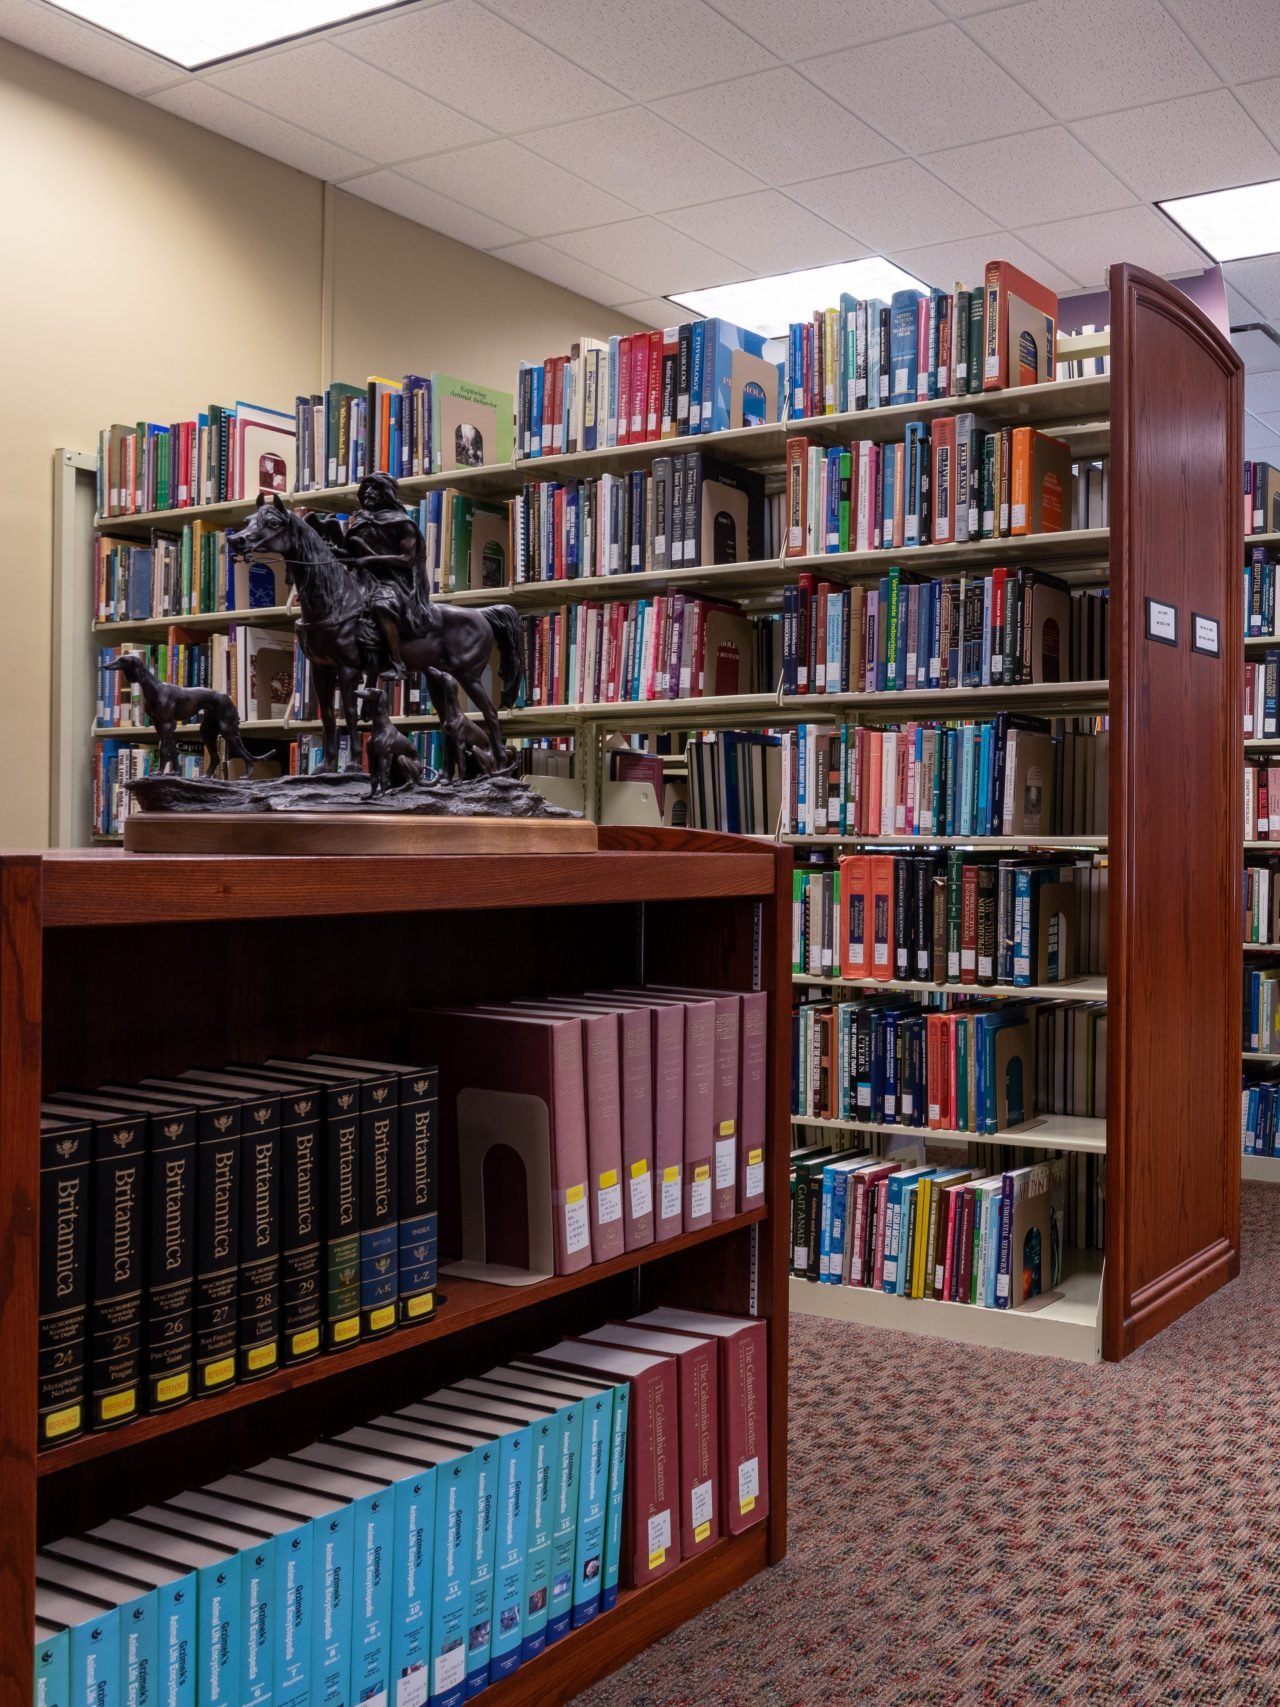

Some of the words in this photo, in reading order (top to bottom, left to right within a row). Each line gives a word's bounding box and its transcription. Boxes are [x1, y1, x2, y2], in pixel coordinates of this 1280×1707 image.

[705, 343, 713, 402] PHYSIOLOGY
[664, 385, 672, 416] Physiology
[339, 1126, 355, 1226] Britannica
[374, 1118, 390, 1216] Britannica
[415, 1111, 431, 1206] Britannica
[255, 1141, 273, 1248] Britannica
[296, 1132, 313, 1236] Britannica
[798, 1184, 806, 1210] GAIT
[165, 1159, 186, 1271] Britannica
[214, 1150, 234, 1259] Britannica
[57, 1177, 80, 1298] Britannica
[114, 1167, 136, 1283] Britannica
[298, 1280, 314, 1295] 29
[413, 1270, 430, 1283] L-Z
[212, 1306, 229, 1322] 27
[256, 1293, 272, 1309] 28
[113, 1333, 131, 1350] 25
[164, 1318, 183, 1336] 26
[54, 1350, 73, 1368] 24
[701, 1360, 709, 1378] The
[746, 1342, 754, 1363] The
[655, 1383, 665, 1403] The
[700, 1379, 711, 1430] Columbia
[745, 1364, 757, 1412] Columbia
[656, 1403, 666, 1453] Columbia
[745, 1413, 756, 1456] Gazetteer
[701, 1431, 710, 1477] Gazetteer
[542, 1465, 550, 1502] Grzimek's
[656, 1455, 665, 1503] Gazetteer
[409, 1504, 417, 1530] Animal
[484, 1494, 492, 1532] Grzimek's
[514, 1480, 522, 1518] Grzimek's
[367, 1522, 375, 1547] Animal
[416, 1528, 424, 1568] Grzimek's
[287, 1560, 296, 1587] Animal
[326, 1543, 334, 1569] Animal
[374, 1545, 382, 1587] Grzimek's
[250, 1578, 259, 1607] Animal
[295, 1584, 304, 1627] Grzimek's
[333, 1566, 342, 1608] Grzimek's
[212, 1596, 221, 1627] Animal
[258, 1602, 268, 1646] Grzimek's
[409, 1604, 421, 1615] 10
[128, 1633, 138, 1665] Animal
[169, 1616, 178, 1646] Animal
[221, 1621, 230, 1666] Grzimek's
[138, 1658, 149, 1706] Grzimek's
[178, 1640, 188, 1686] Grzimek's
